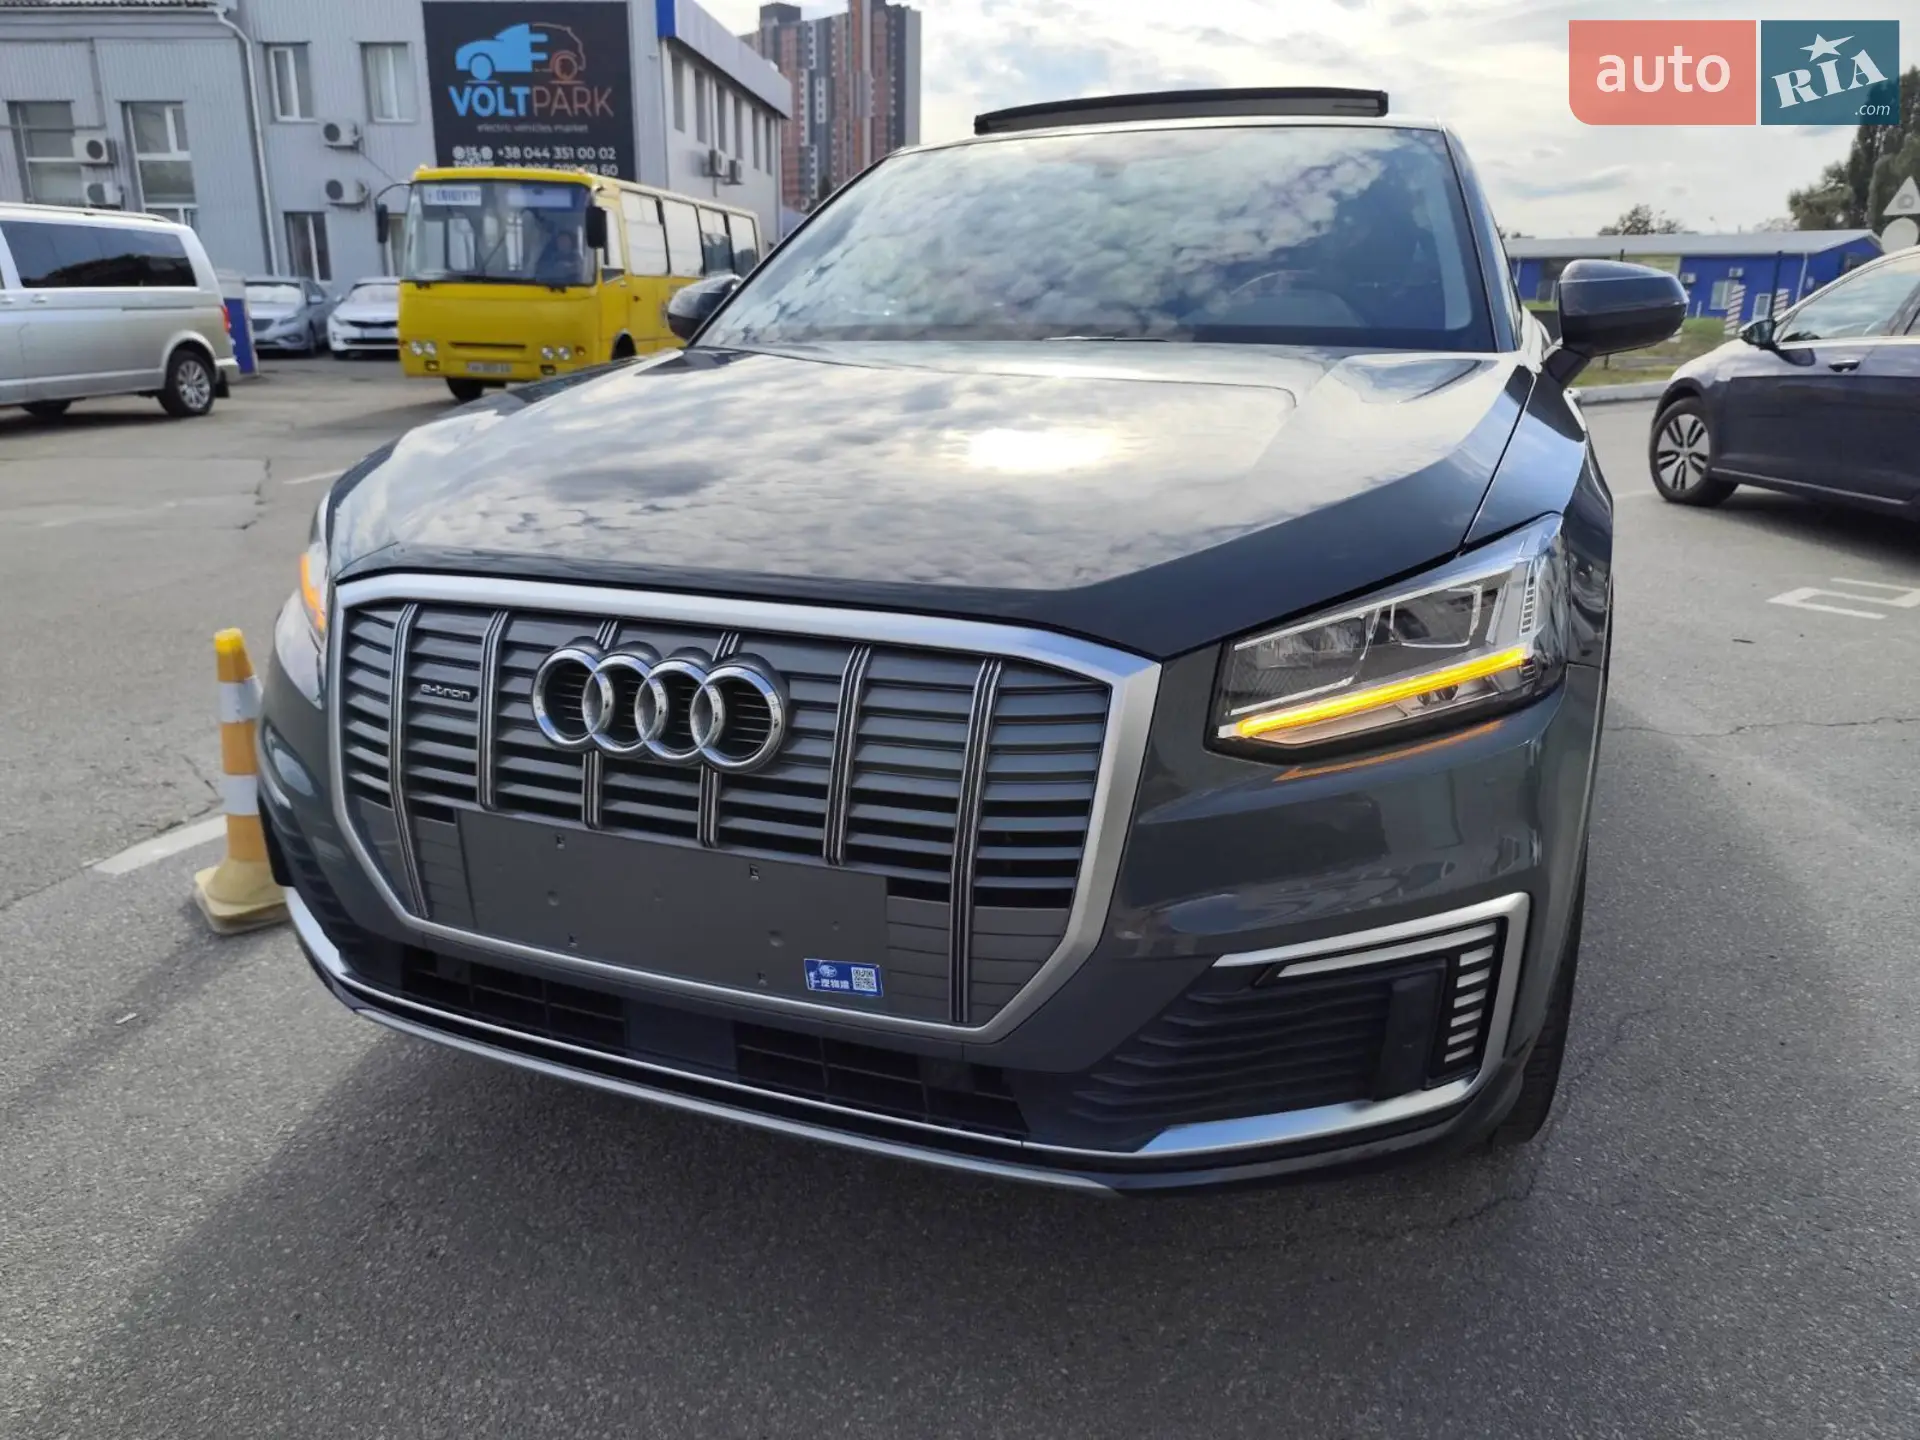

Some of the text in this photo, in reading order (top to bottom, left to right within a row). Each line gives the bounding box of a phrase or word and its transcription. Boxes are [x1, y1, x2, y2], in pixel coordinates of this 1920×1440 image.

[448, 86, 614, 117] VOLTPARK
[523, 146, 550, 160] 044
[552, 146, 575, 160] 351
[577, 146, 596, 160] 00
[599, 146, 616, 160] 02
[420, 684, 470, 700] e-tron
